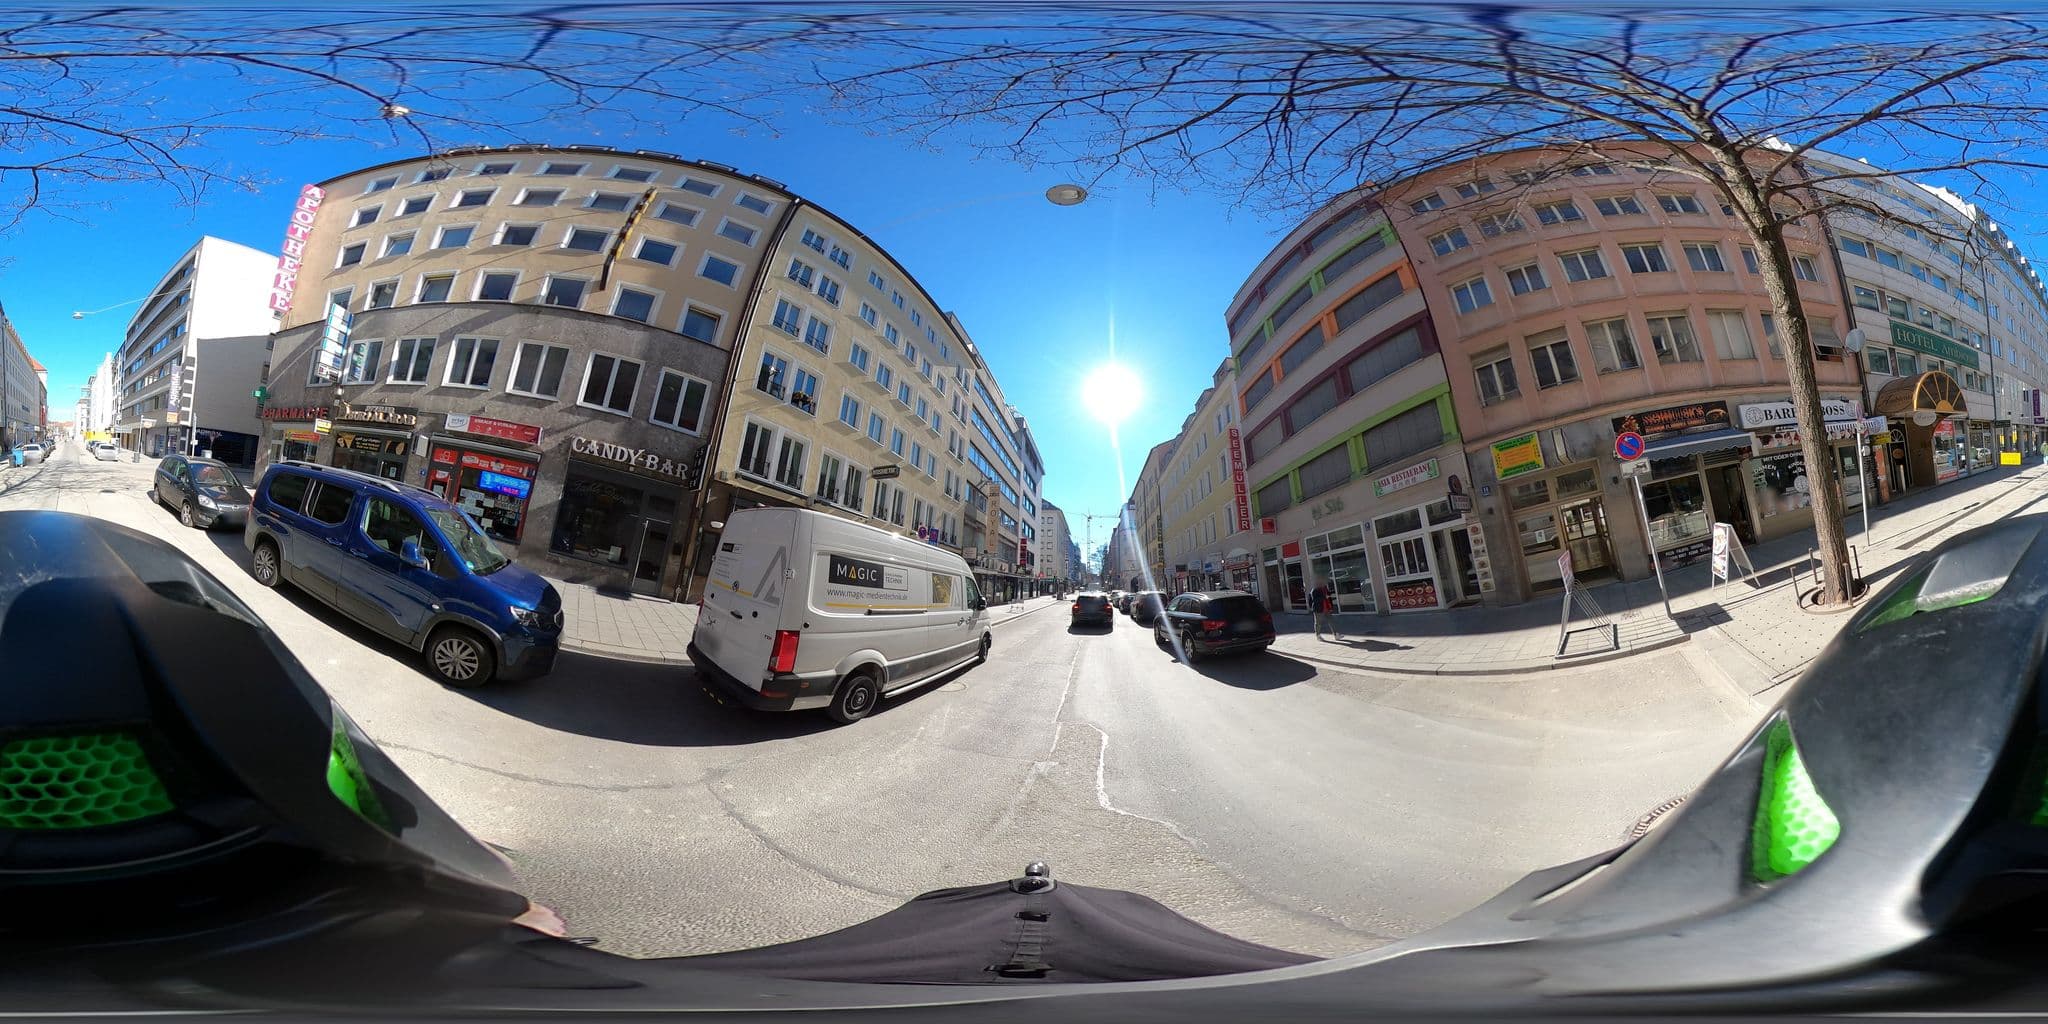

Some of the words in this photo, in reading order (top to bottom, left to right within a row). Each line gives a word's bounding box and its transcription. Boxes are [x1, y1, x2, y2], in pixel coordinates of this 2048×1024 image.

[273, 186, 324, 310] APOTHEKE
[1896, 328, 1938, 351] HOTEL
[263, 406, 329, 420] PHARMACIE
[572, 437, 688, 479] CANDY-BAR
[1391, 463, 1431, 484] RESTAURANT
[836, 563, 877, 581] MAGIC
